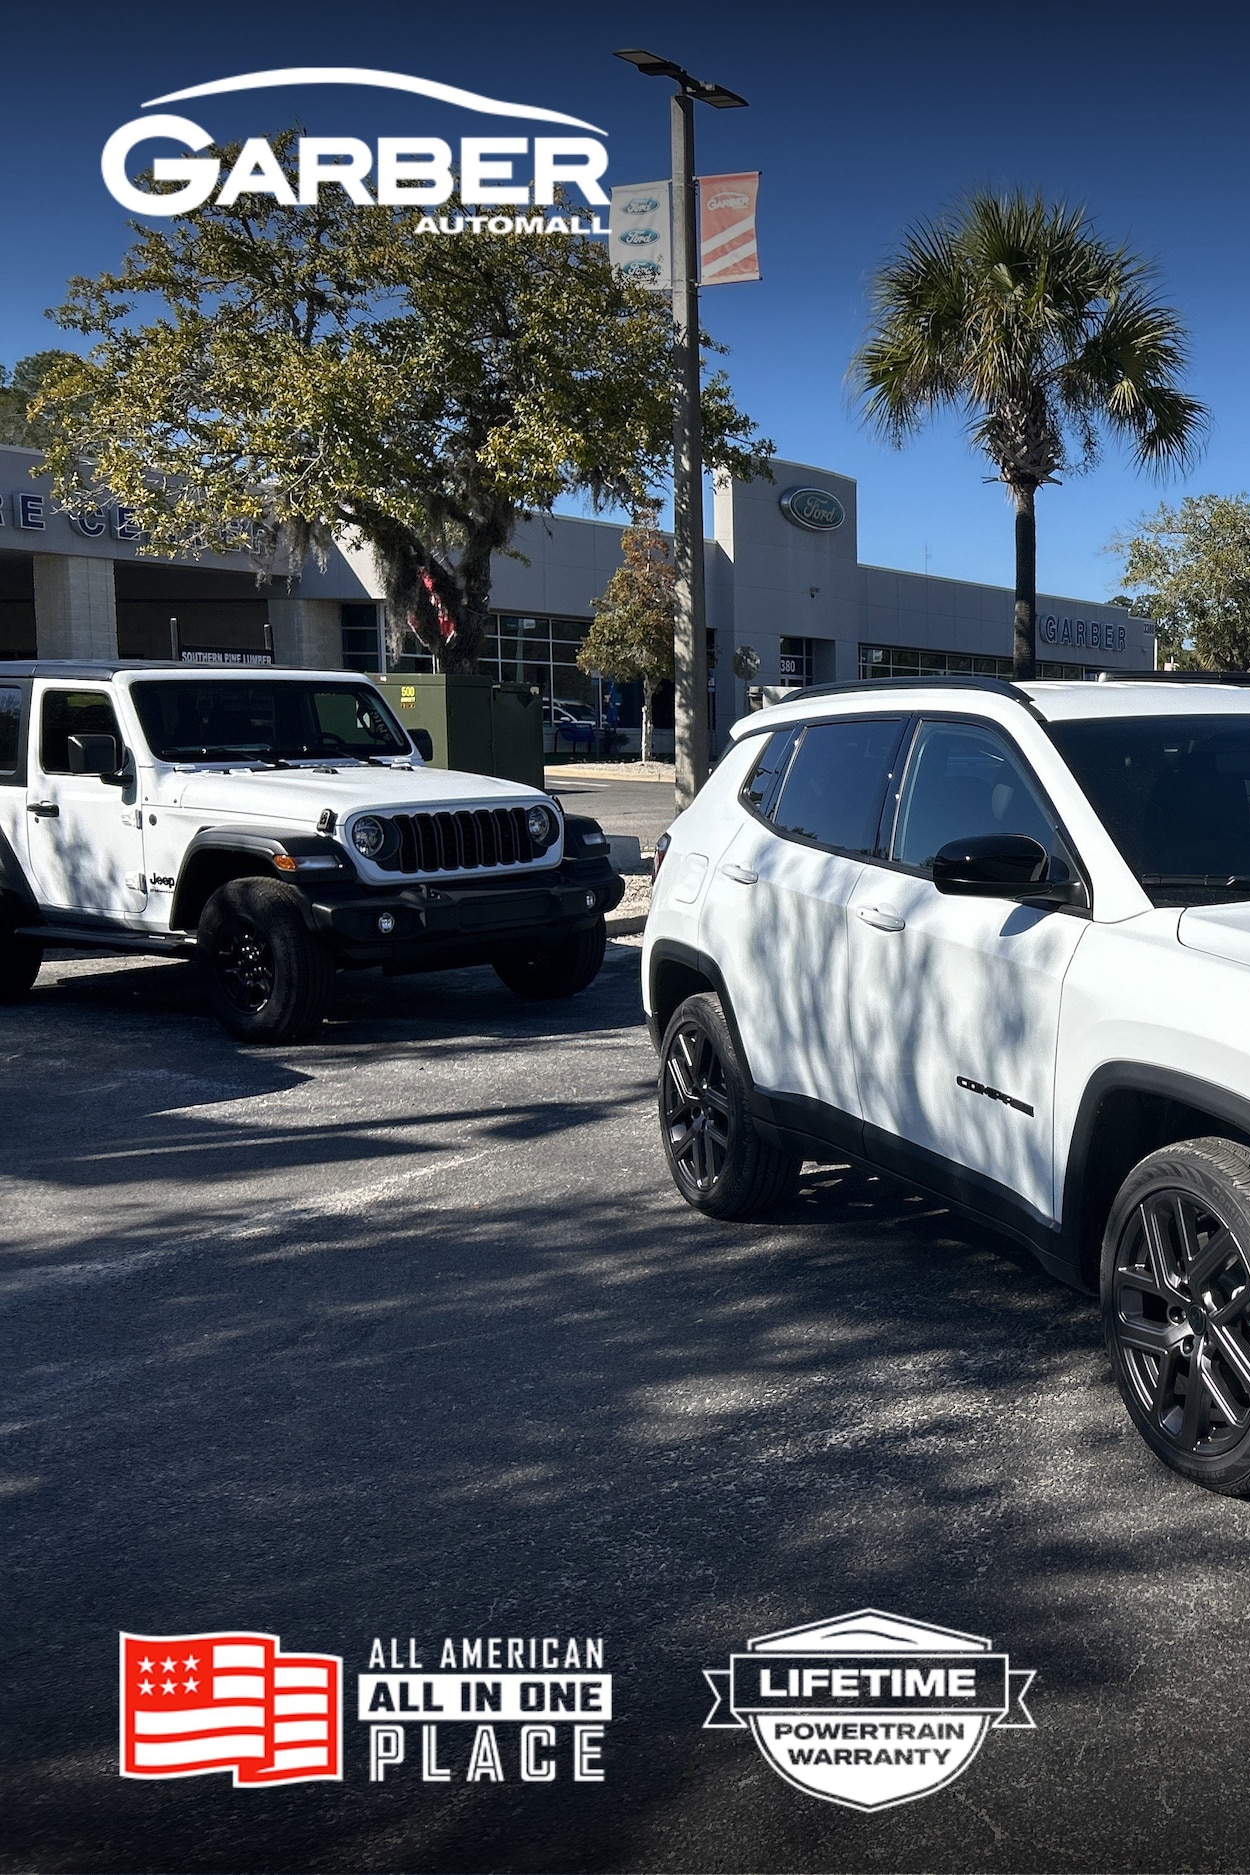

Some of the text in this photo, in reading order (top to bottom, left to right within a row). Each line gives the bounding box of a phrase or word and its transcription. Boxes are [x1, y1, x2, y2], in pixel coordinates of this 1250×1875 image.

[626, 196, 652, 213] Ford
[707, 197, 749, 212] GARBER
[625, 229, 652, 244] Ford
[627, 261, 653, 276] Ford
[803, 496, 836, 523] Ford
[1045, 614, 1127, 652] GARBER
[182, 651, 272, 665] SOUTHERN PINE LUMBER
[150, 872, 176, 889] Jeep
